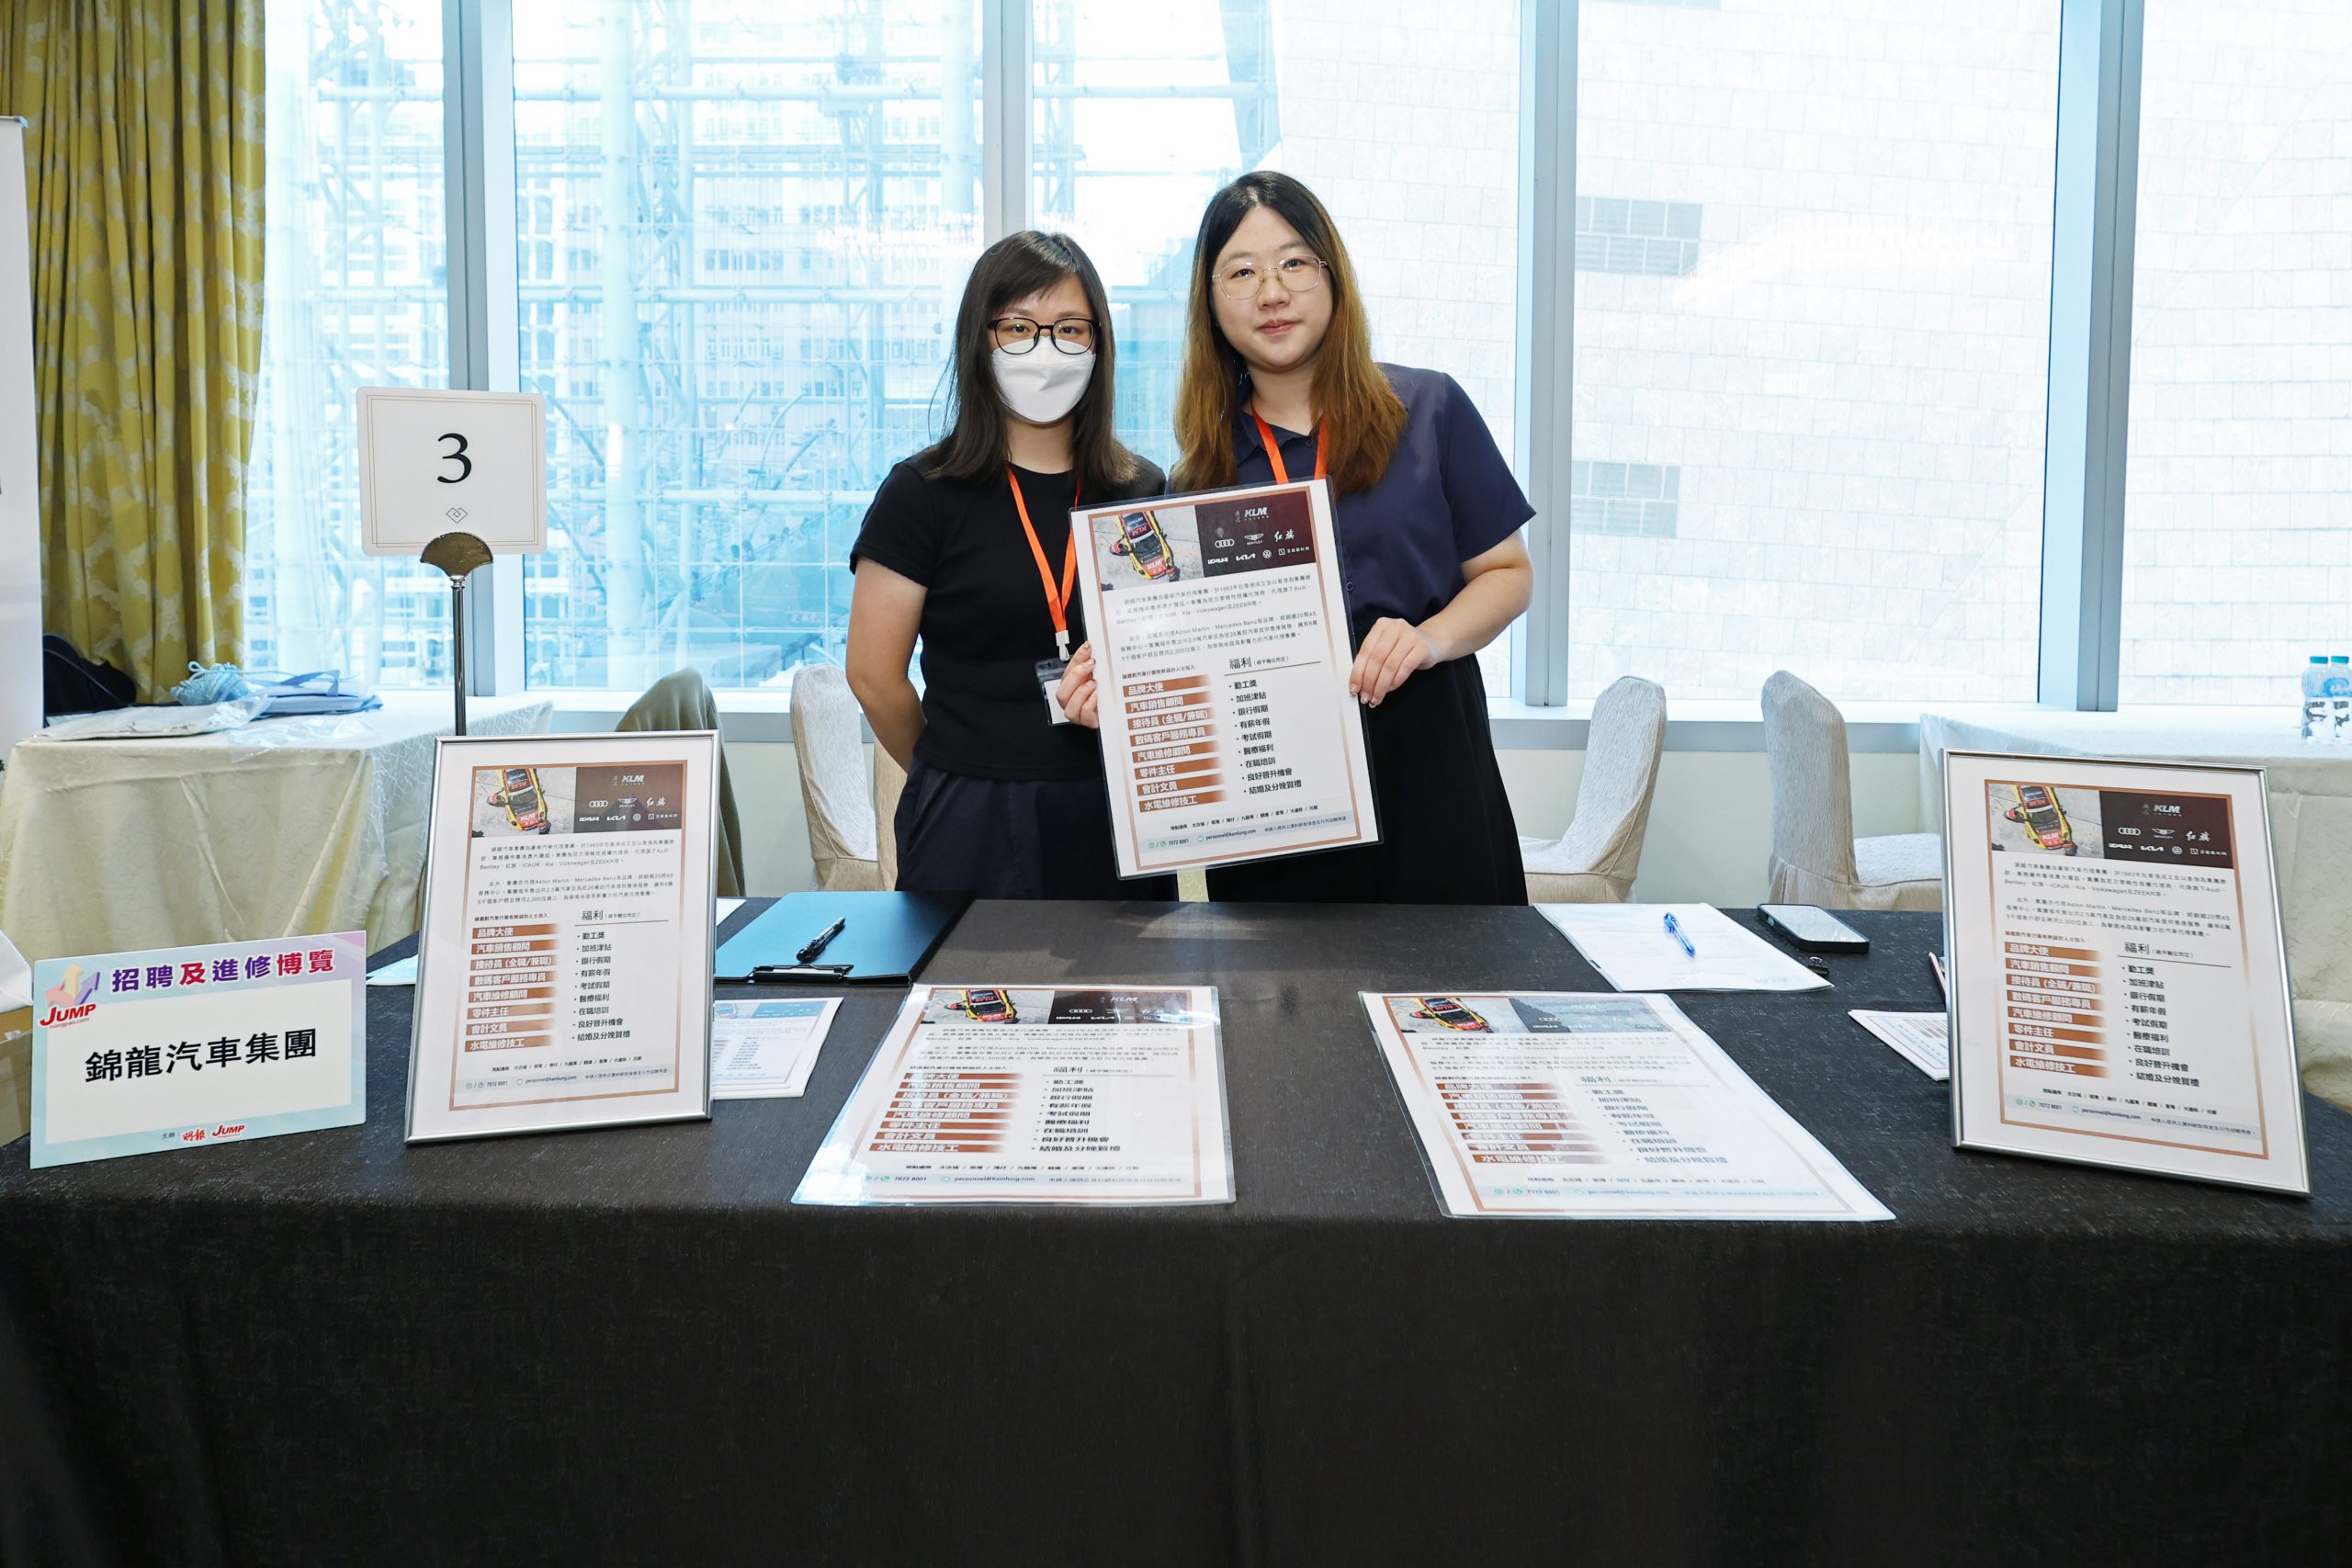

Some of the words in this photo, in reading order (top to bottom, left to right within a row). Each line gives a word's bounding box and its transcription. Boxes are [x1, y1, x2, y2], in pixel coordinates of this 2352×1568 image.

[437, 433, 471, 483] 3
[1243, 506, 1268, 517] KLM
[1228, 656, 1251, 670] 福利
[1236, 691, 1266, 703] 加班津貼
[1238, 705, 1268, 716] 銀行假期
[1239, 717, 1270, 728] 有薪年假
[1241, 730, 1272, 741] 考試假期
[1243, 743, 1273, 755] 醫療福利
[1245, 756, 1275, 768] 在職培訓
[621, 774, 644, 783] KLM
[2153, 804, 2180, 813] KLM
[582, 909, 603, 920] 福利
[2124, 942, 2150, 954] 福利
[112, 949, 334, 992] 招聘及進修博覽
[40, 1004, 96, 1026] JUMP
[85, 1028, 317, 1083] 錦龍汽車集團
[211, 1124, 245, 1136] JUMP
